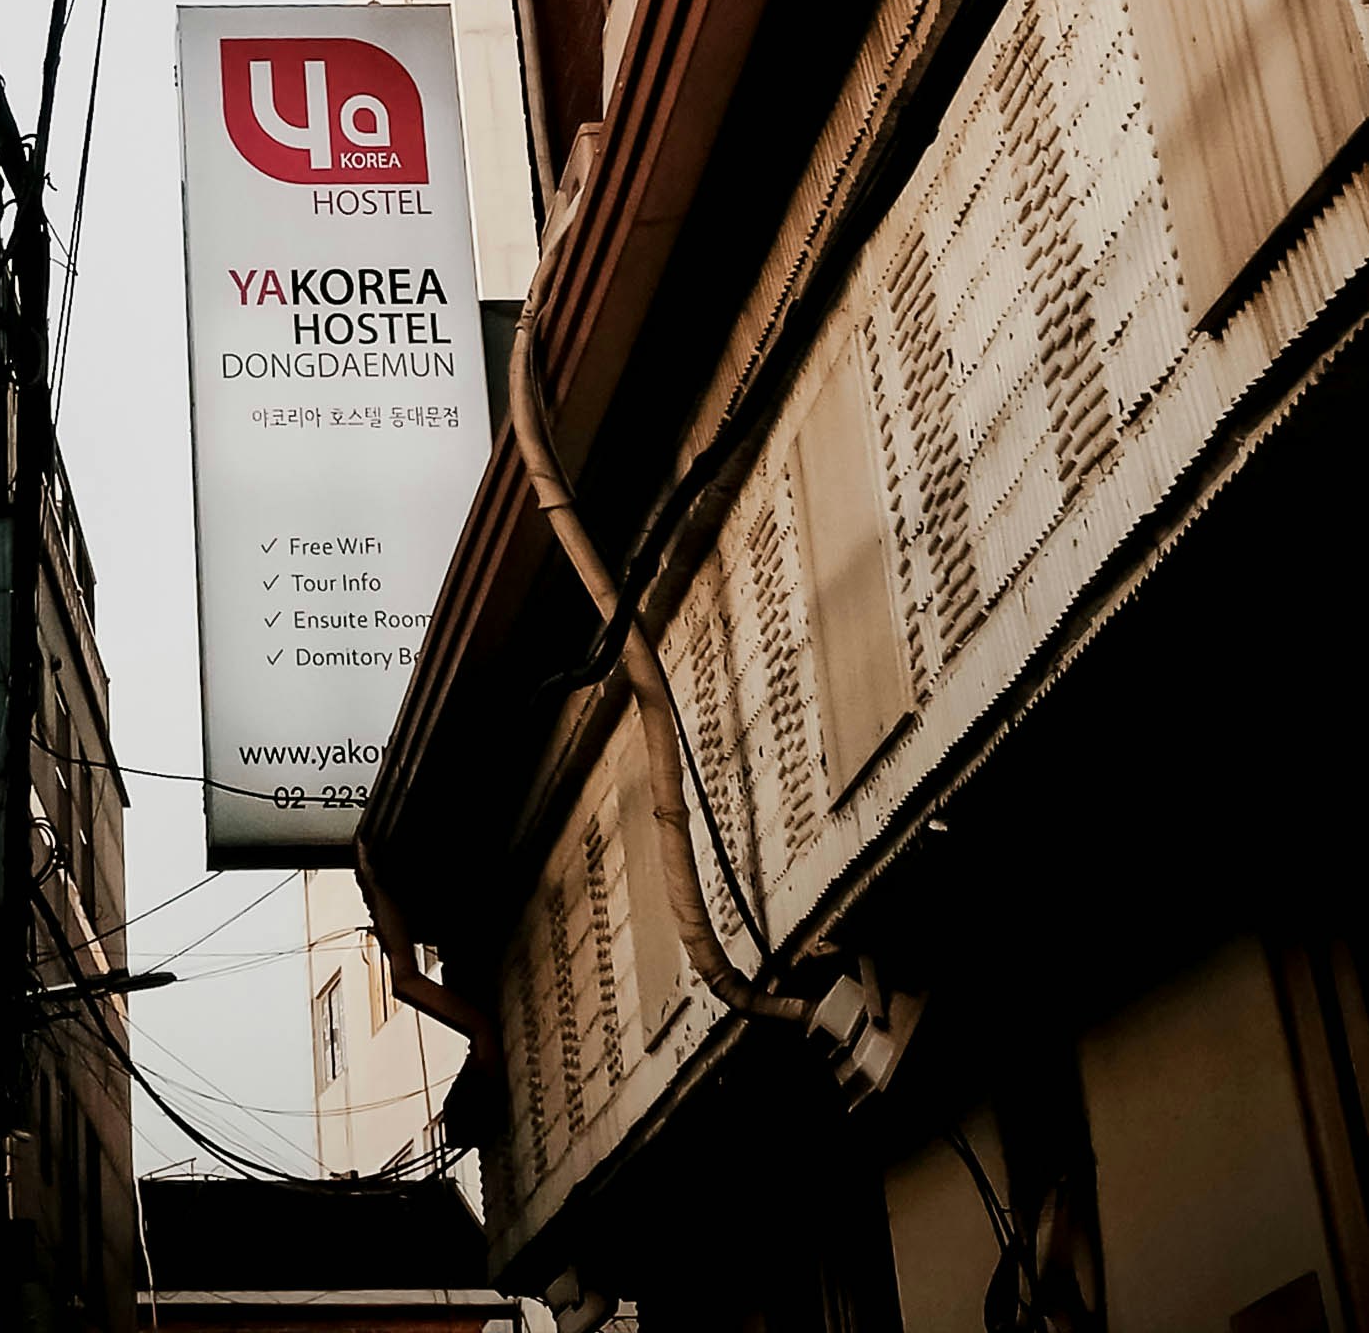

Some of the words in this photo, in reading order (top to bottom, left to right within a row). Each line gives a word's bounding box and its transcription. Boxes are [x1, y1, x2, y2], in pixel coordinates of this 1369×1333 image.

[340, 152, 401, 169] KOREA
[313, 189, 432, 215] HOSTEL
[228, 268, 448, 305] YAKOREA
[294, 312, 452, 345] HOSTEL
[222, 352, 455, 379] DONGDAEMUN
[251, 407, 322, 429] 야코리아
[329, 407, 382, 429] 호스텔
[388, 405, 460, 429] 동대문점
[289, 537, 333, 555] Free
[336, 537, 382, 554] WiFi
[291, 574, 337, 592] Tour
[342, 572, 381, 592] Info
[294, 610, 368, 629] Ensuite
[296, 647, 393, 671] Domitory
[274, 786, 306, 809] 02
